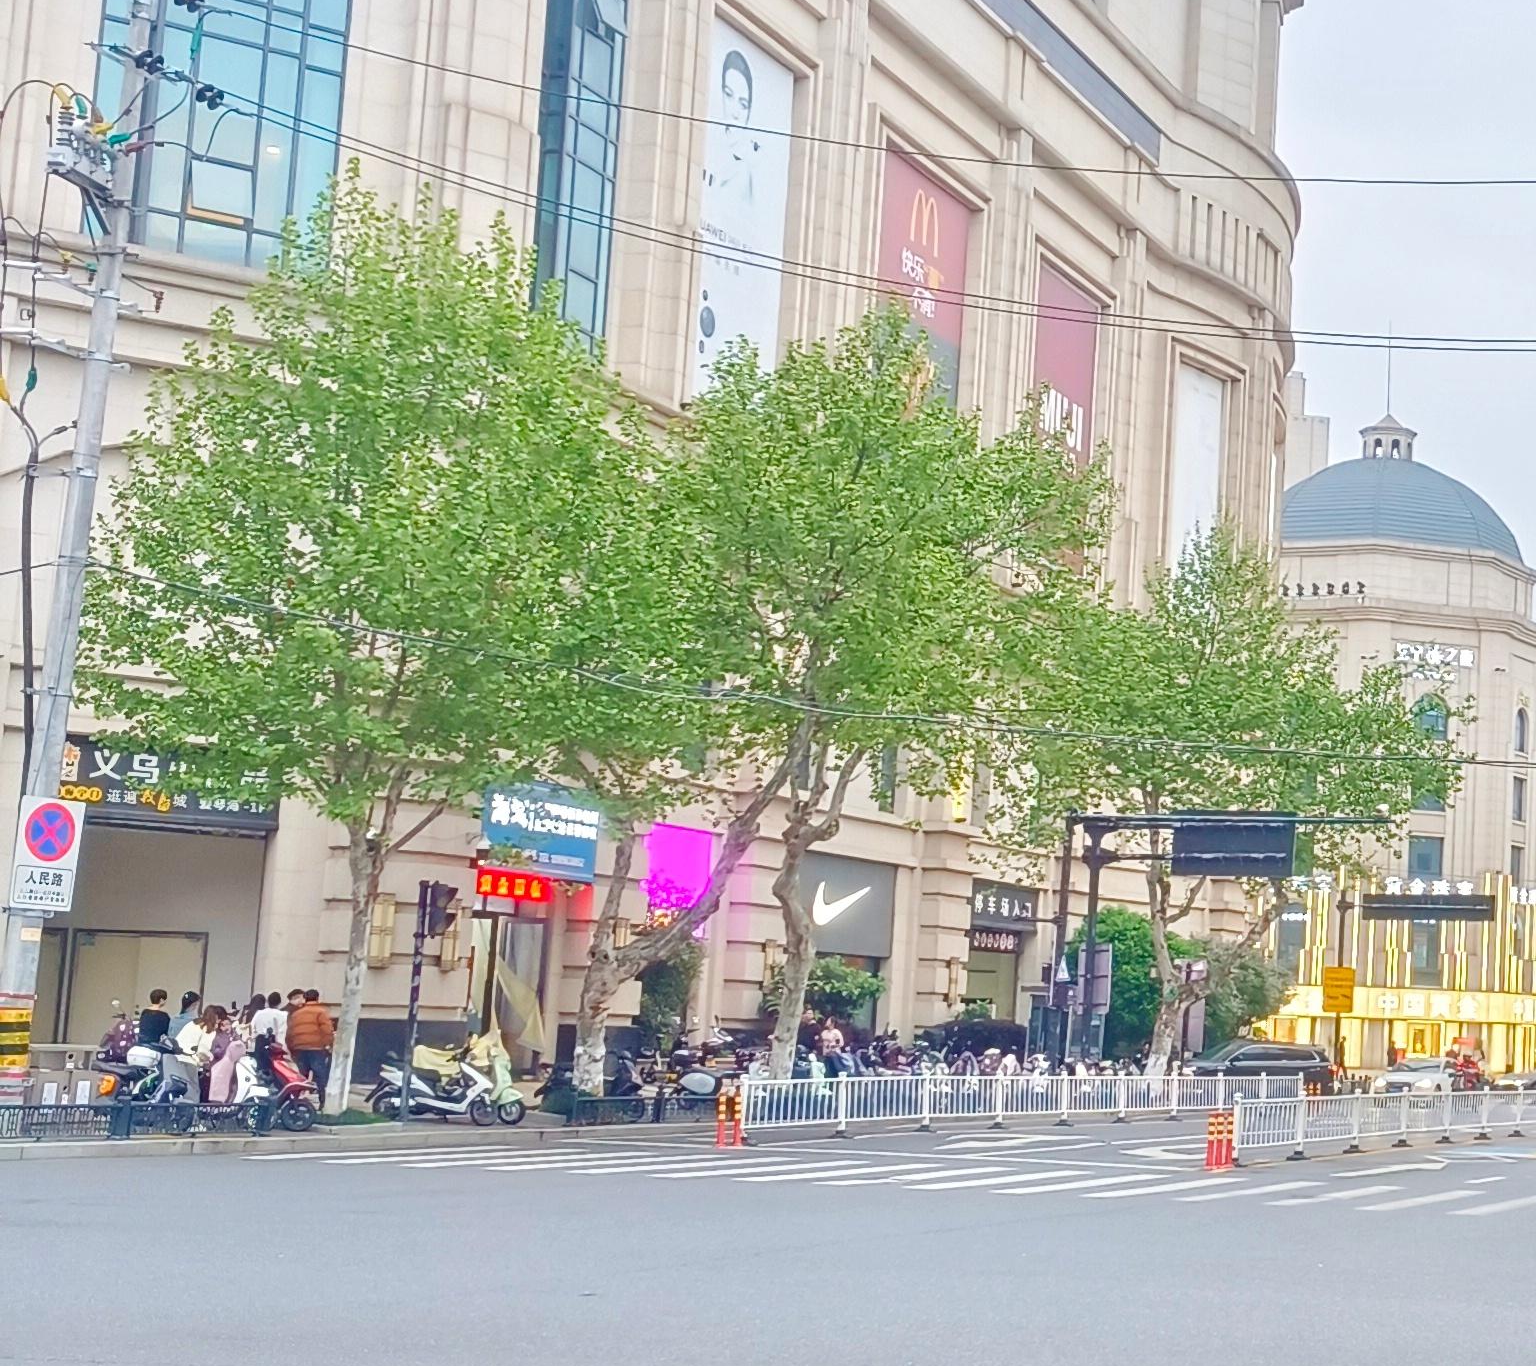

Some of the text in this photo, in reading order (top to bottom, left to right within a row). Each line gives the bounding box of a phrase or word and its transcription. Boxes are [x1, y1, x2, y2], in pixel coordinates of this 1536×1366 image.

[699, 218, 727, 242] UAWEI
[24, 871, 64, 887] 人民路
[974, 894, 1032, 918] 停车场入口
